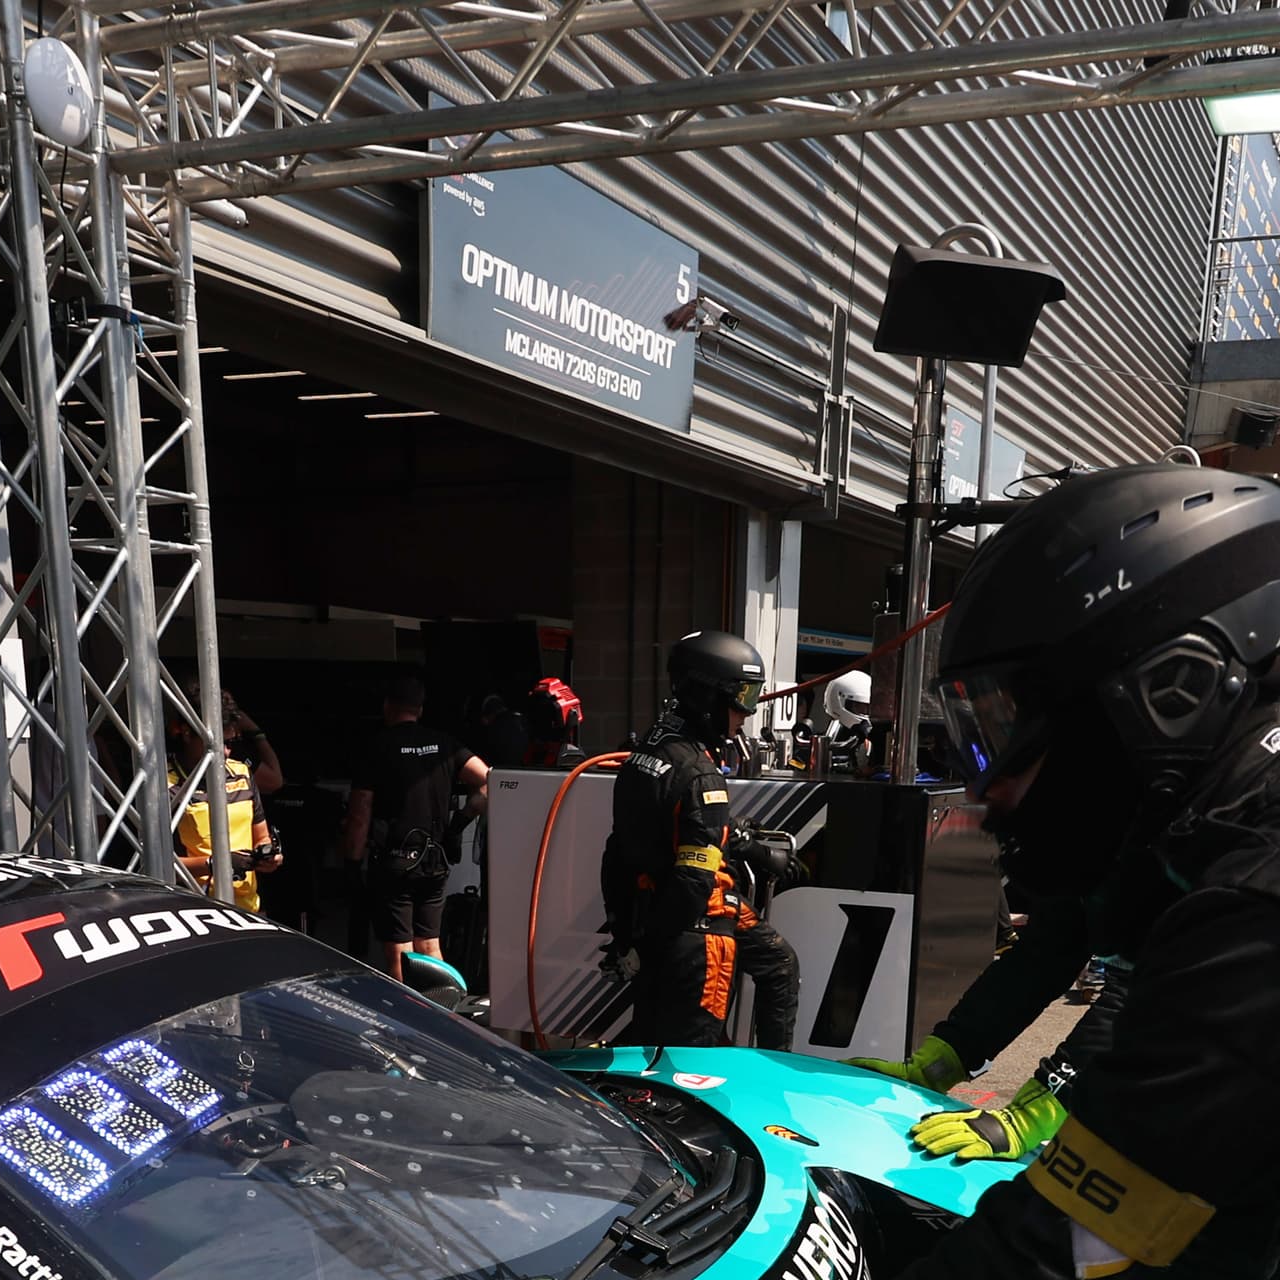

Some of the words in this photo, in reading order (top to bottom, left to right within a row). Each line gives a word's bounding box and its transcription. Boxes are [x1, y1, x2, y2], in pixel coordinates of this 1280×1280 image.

[461, 244, 559, 321] OPTIMUM
[560, 288, 677, 370] MOTORSPORT
[676, 263, 691, 304] 5
[505, 328, 565, 373] MCLAREN
[566, 352, 597, 385] 720S
[597, 366, 619, 394] GT3
[620, 377, 642, 402] EVO
